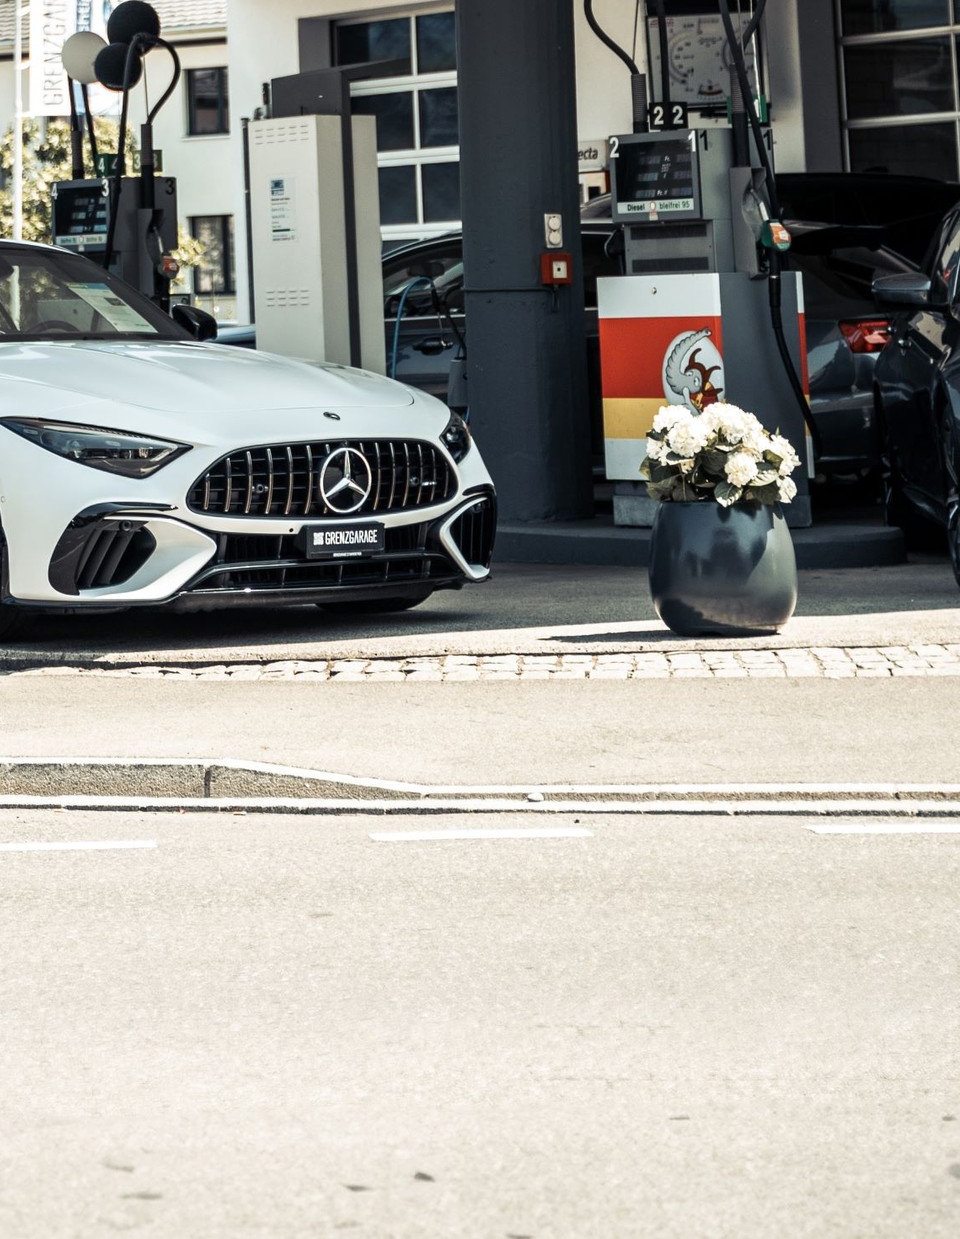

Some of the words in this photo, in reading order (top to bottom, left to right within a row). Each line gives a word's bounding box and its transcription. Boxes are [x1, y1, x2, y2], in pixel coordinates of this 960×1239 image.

[653, 106, 664, 126] 2
[672, 105, 684, 125] 2
[609, 136, 620, 158] 2
[687, 130, 697, 153] 1
[698, 130, 709, 151] 1
[98, 157, 105, 173] 4
[50, 183, 58, 200] 4
[101, 178, 110, 197] 3
[165, 178, 175, 196] 3
[627, 203, 646, 212] Diesel
[659, 202, 681, 211] bleifrei
[324, 529, 378, 545] GRENZGARAGE
